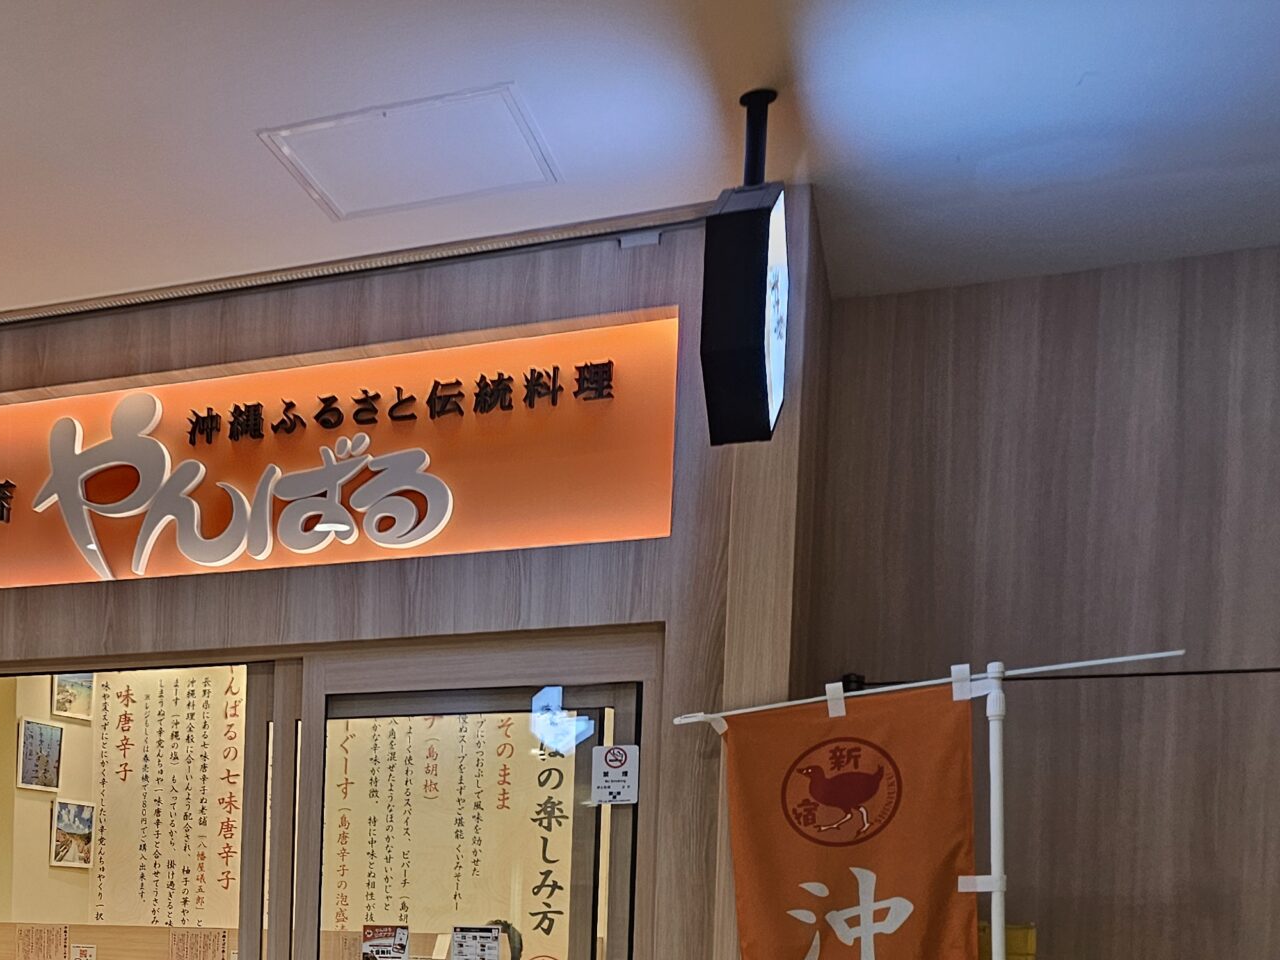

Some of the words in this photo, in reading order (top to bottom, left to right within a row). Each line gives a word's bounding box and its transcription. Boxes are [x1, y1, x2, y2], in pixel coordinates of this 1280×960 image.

[186, 359, 617, 446] 沖縄ふるさと伝統料理
[33, 391, 454, 580] やんばる
[217, 665, 243, 890] んばるの七味唐辛子
[496, 716, 515, 810] そのまま
[829, 746, 862, 771] 新
[792, 799, 820, 826] 宿
